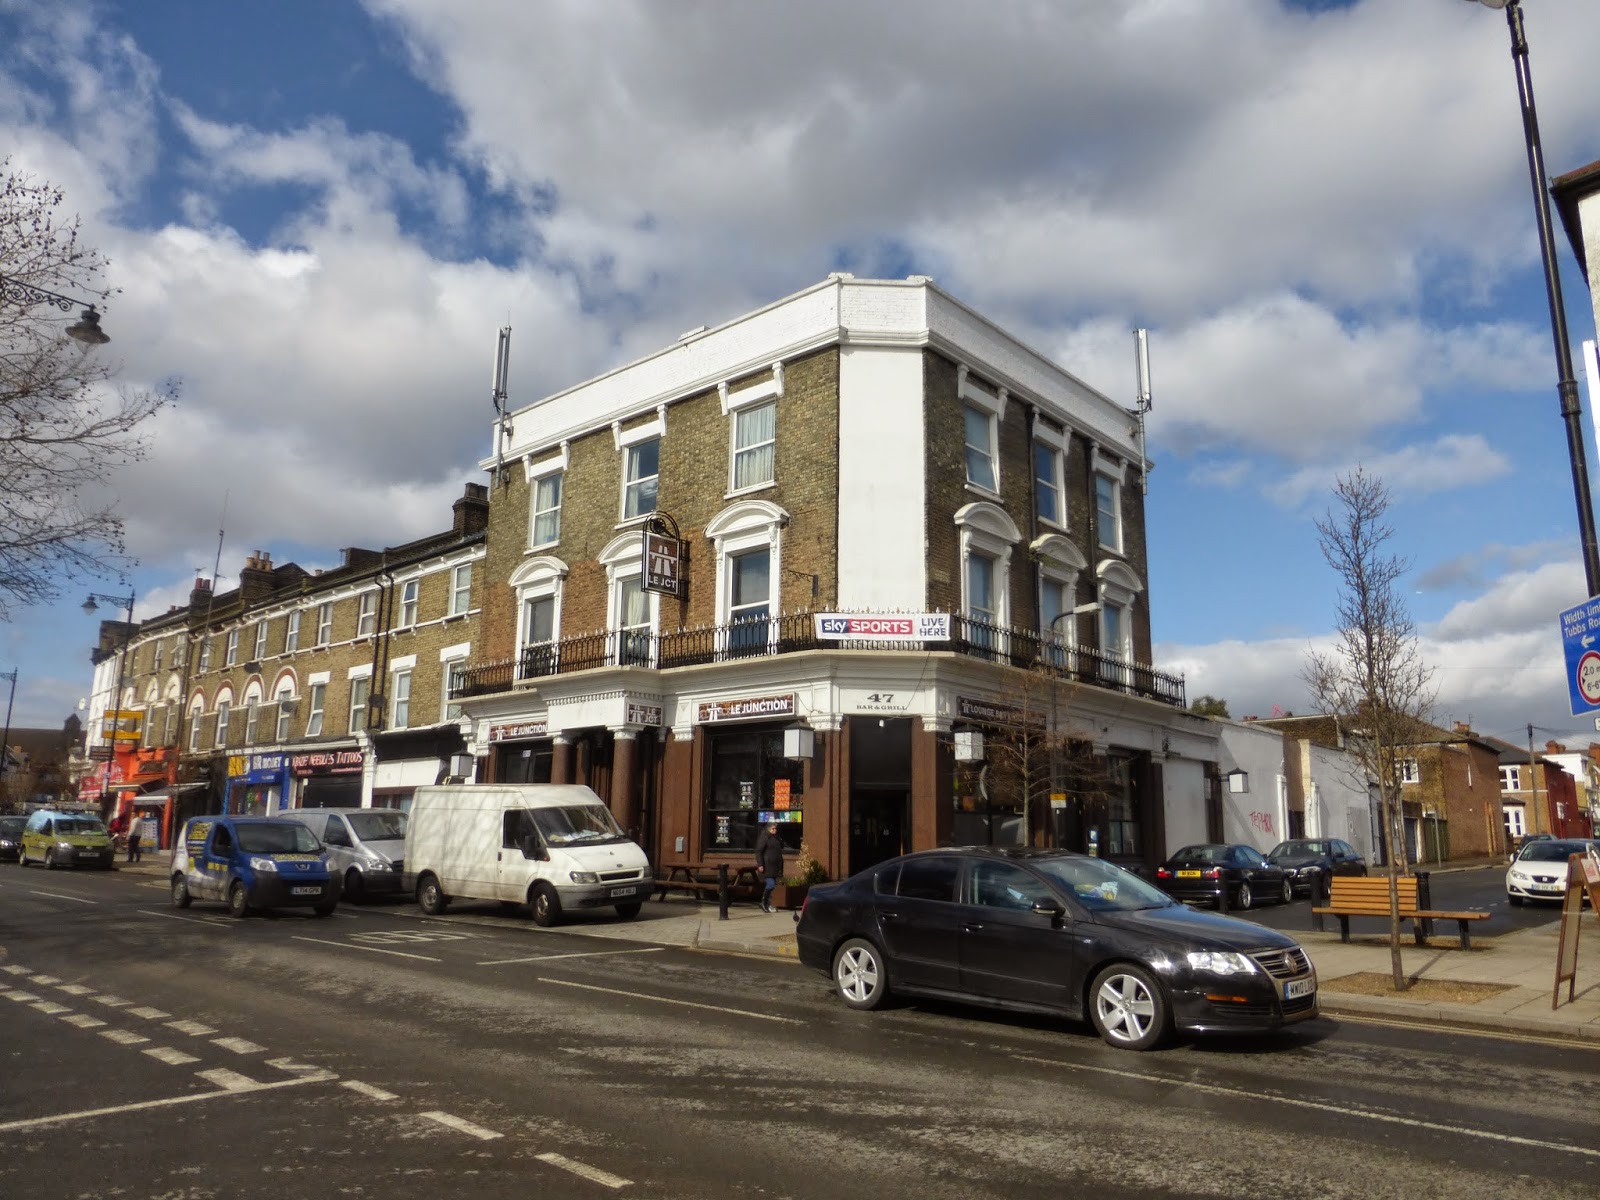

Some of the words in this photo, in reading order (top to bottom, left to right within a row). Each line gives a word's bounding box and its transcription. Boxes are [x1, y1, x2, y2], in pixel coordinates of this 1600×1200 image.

[648, 574, 659, 585] LE
[661, 577, 677, 589] JCT
[921, 617, 944, 627] LIVE
[1563, 609, 1585, 626] Width
[823, 619, 847, 633] sky
[850, 620, 910, 633] SPORTS
[919, 627, 946, 637] HERE
[1564, 623, 1587, 638] Tubbs
[1588, 617, 1600, 630] Ro
[1582, 665, 1595, 676] 2.0
[866, 693, 895, 703] 47
[647, 707, 656, 716] LE
[730, 704, 741, 715] LE
[742, 699, 788, 714] JUNCTION
[970, 704, 995, 718] LOUNGE
[644, 714, 659, 724] JCT
[510, 726, 518, 736] LE
[518, 722, 548, 735] JUNCTION
[336, 751, 363, 764] TATTOOS
